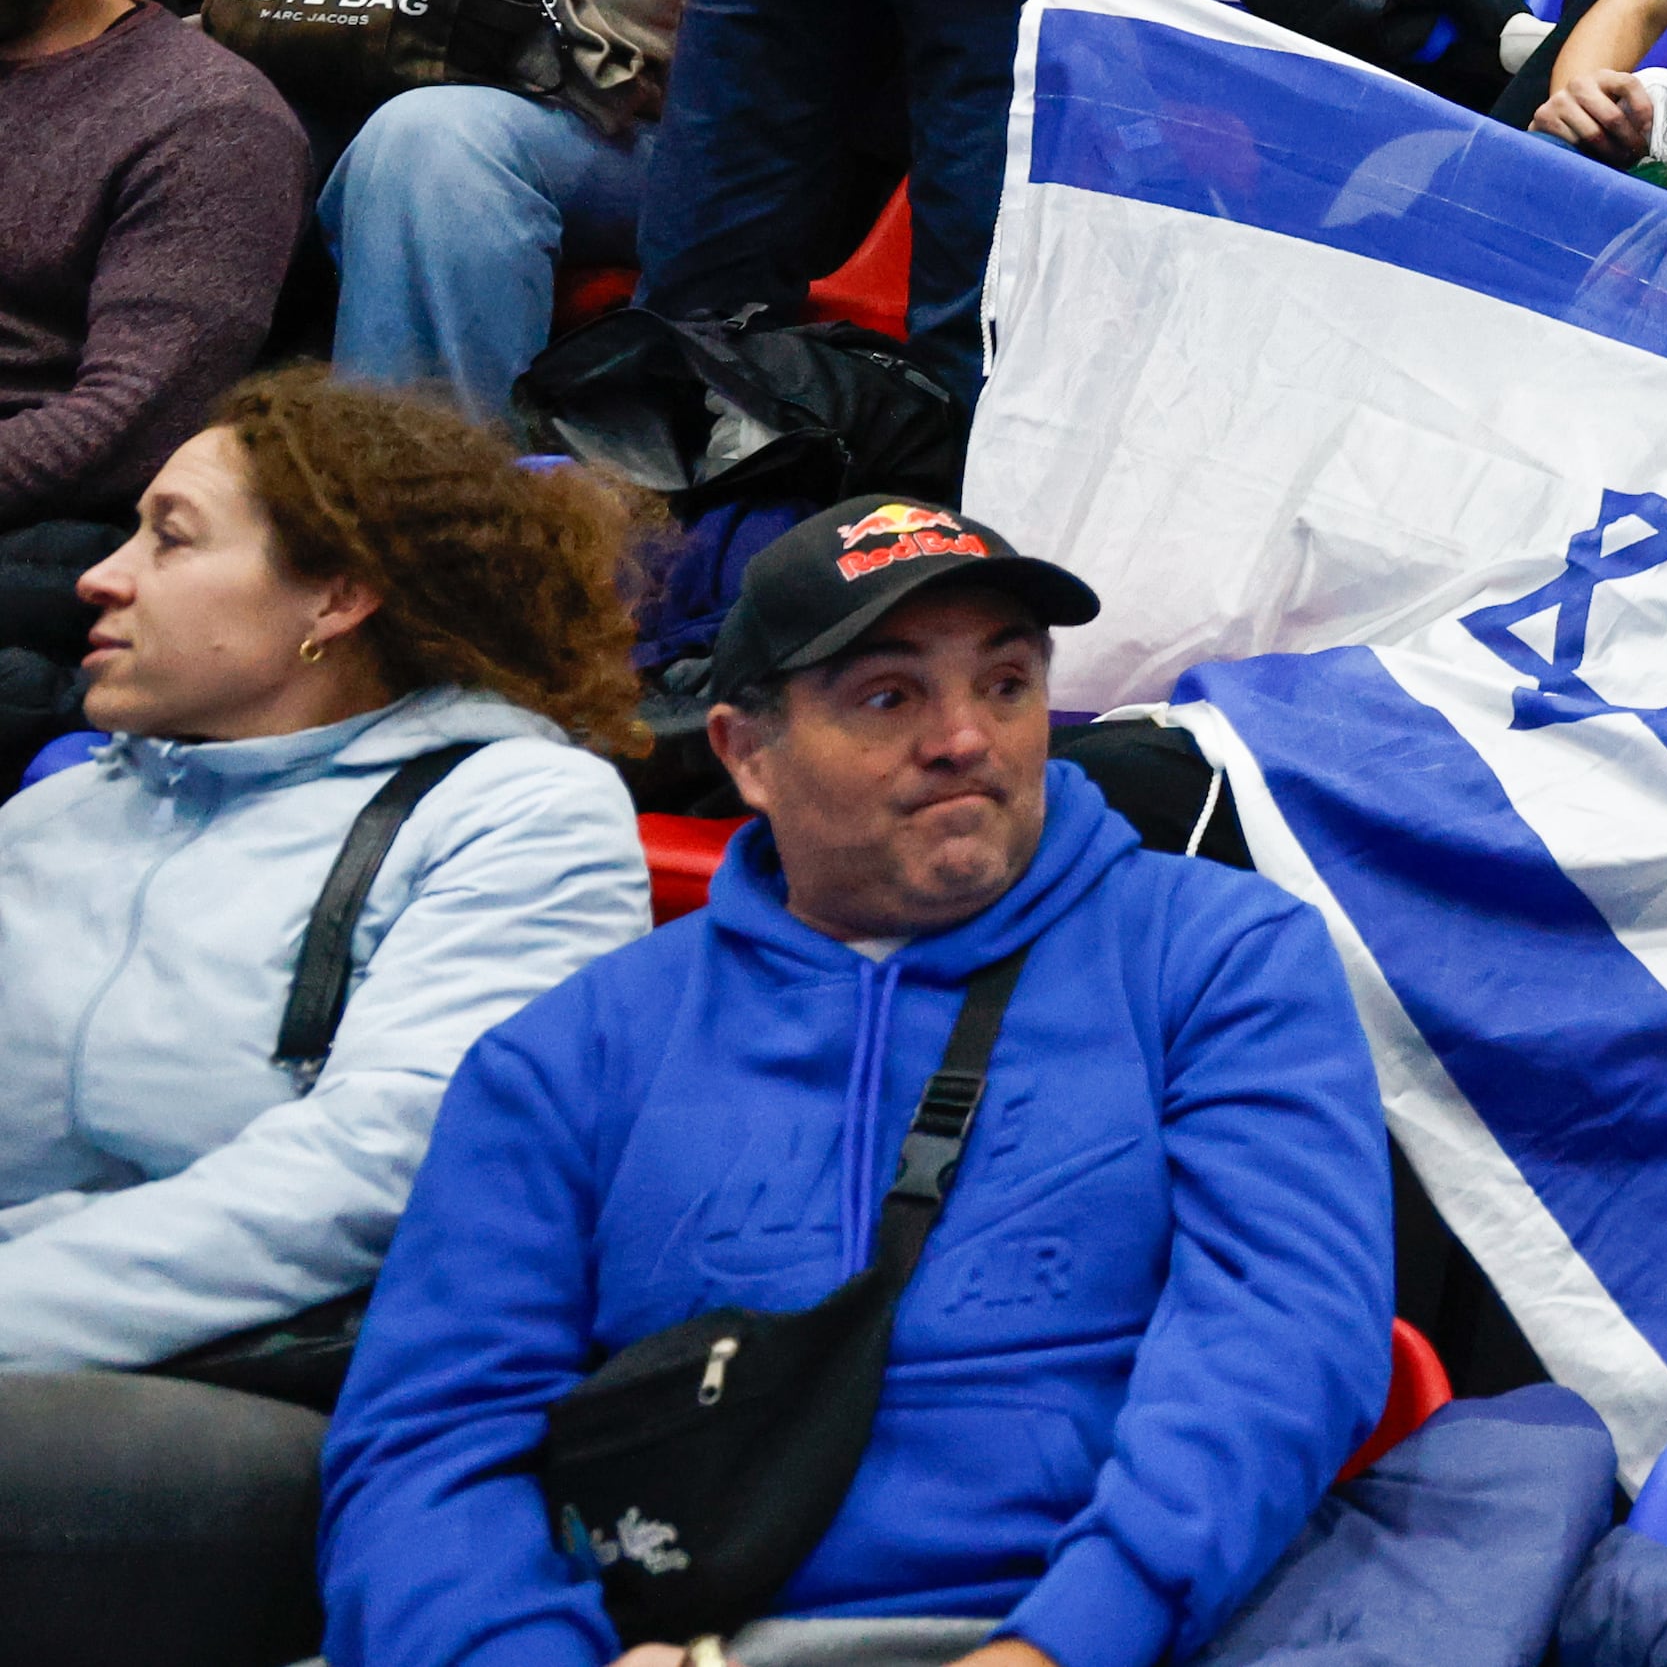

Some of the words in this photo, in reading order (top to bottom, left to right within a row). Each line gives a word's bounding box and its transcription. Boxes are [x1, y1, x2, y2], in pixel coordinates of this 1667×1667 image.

[258, 8, 304, 22] MARC
[306, 13, 370, 26] JACOBS
[836, 533, 924, 582] Red
[913, 530, 989, 559] Bull
